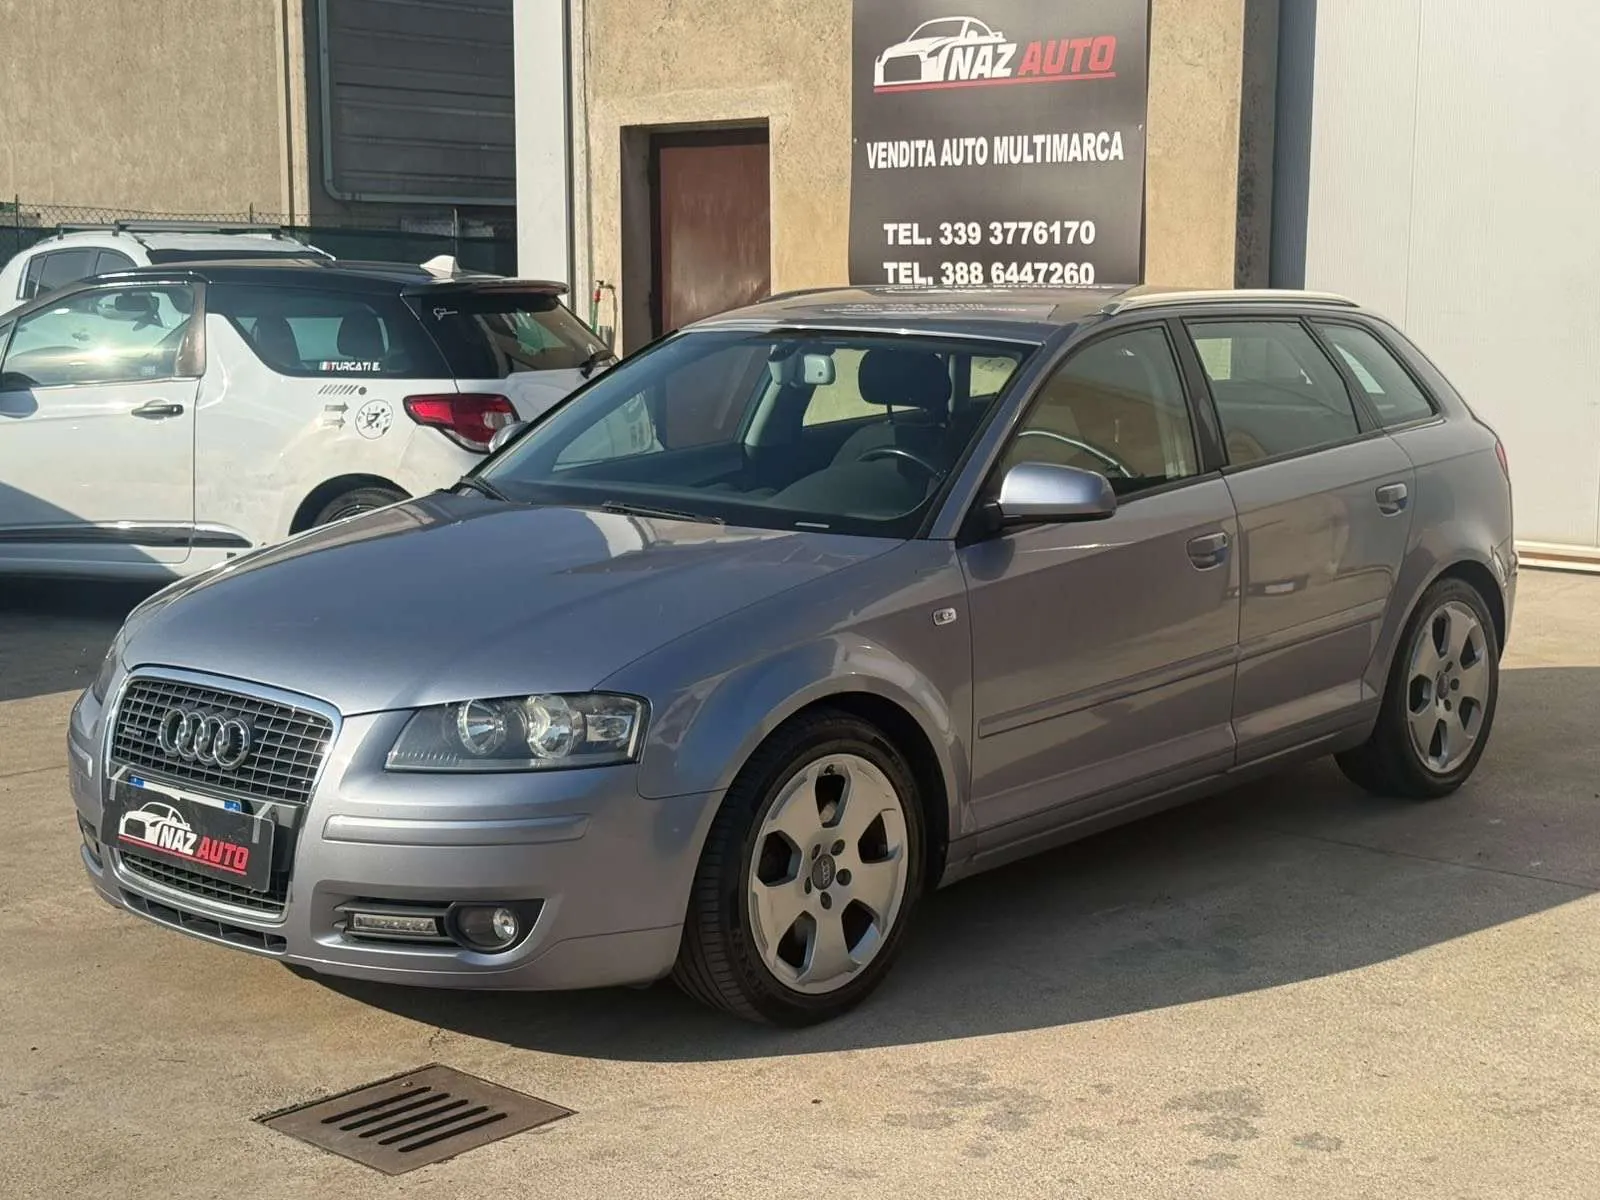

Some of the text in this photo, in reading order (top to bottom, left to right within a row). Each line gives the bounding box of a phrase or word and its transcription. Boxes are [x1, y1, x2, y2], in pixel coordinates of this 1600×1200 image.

[948, 35, 1117, 81] NAZ AUTO
[866, 131, 1124, 169] VENDITA AUTO MULTIMARCA
[883, 221, 1096, 245] TEL. 339 3776170
[883, 262, 1095, 285] TEL. 388 6447260
[331, 361, 371, 371] TURCATI
[158, 825, 249, 870] NAZ AUTO
